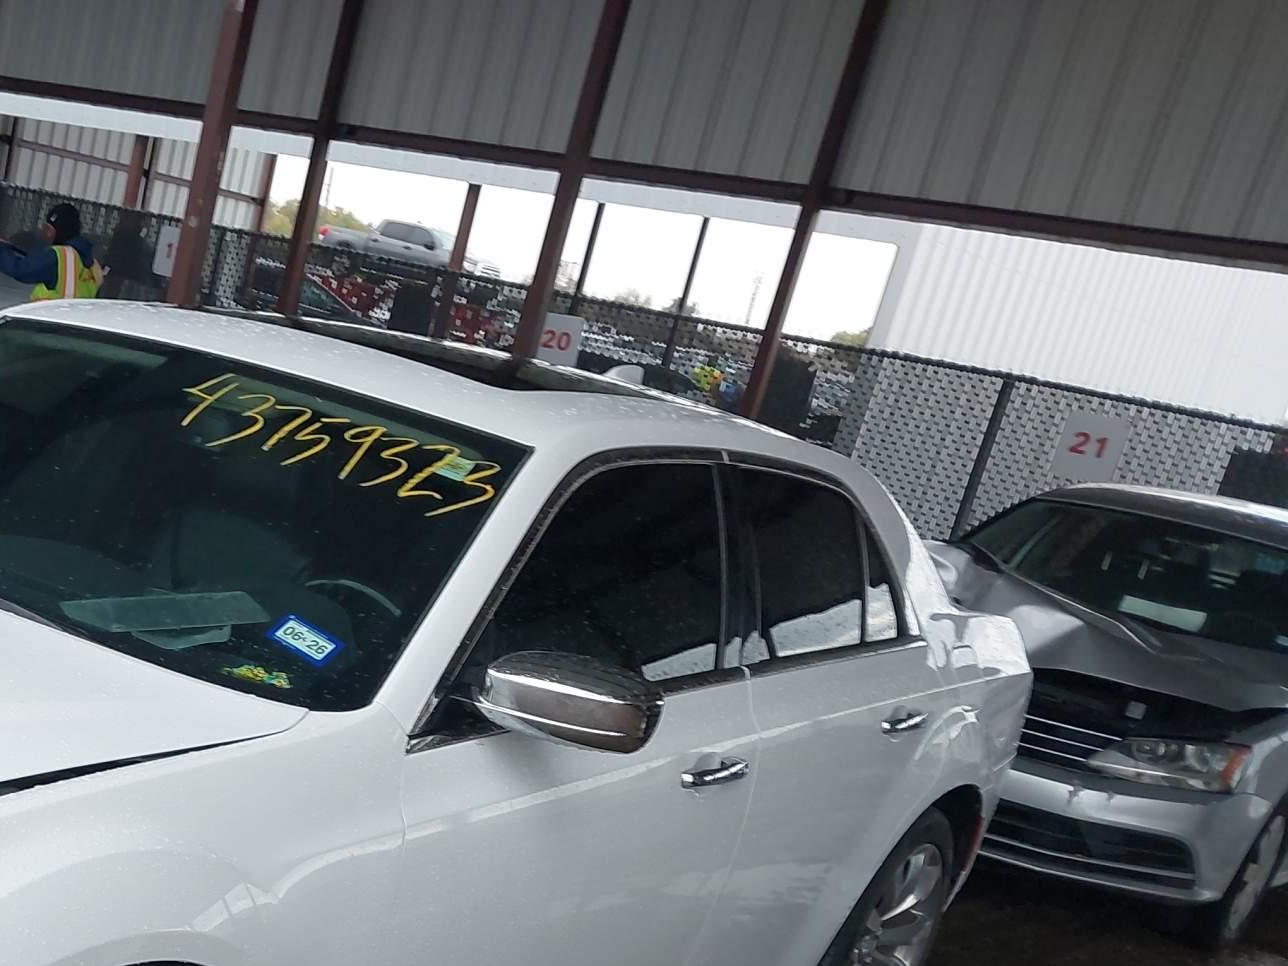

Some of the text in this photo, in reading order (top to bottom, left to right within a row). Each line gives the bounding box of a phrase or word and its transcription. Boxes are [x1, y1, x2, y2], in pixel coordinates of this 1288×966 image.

[541, 329, 572, 351] 20
[181, 373, 503, 517] 43759323
[1068, 431, 1109, 459] 21
